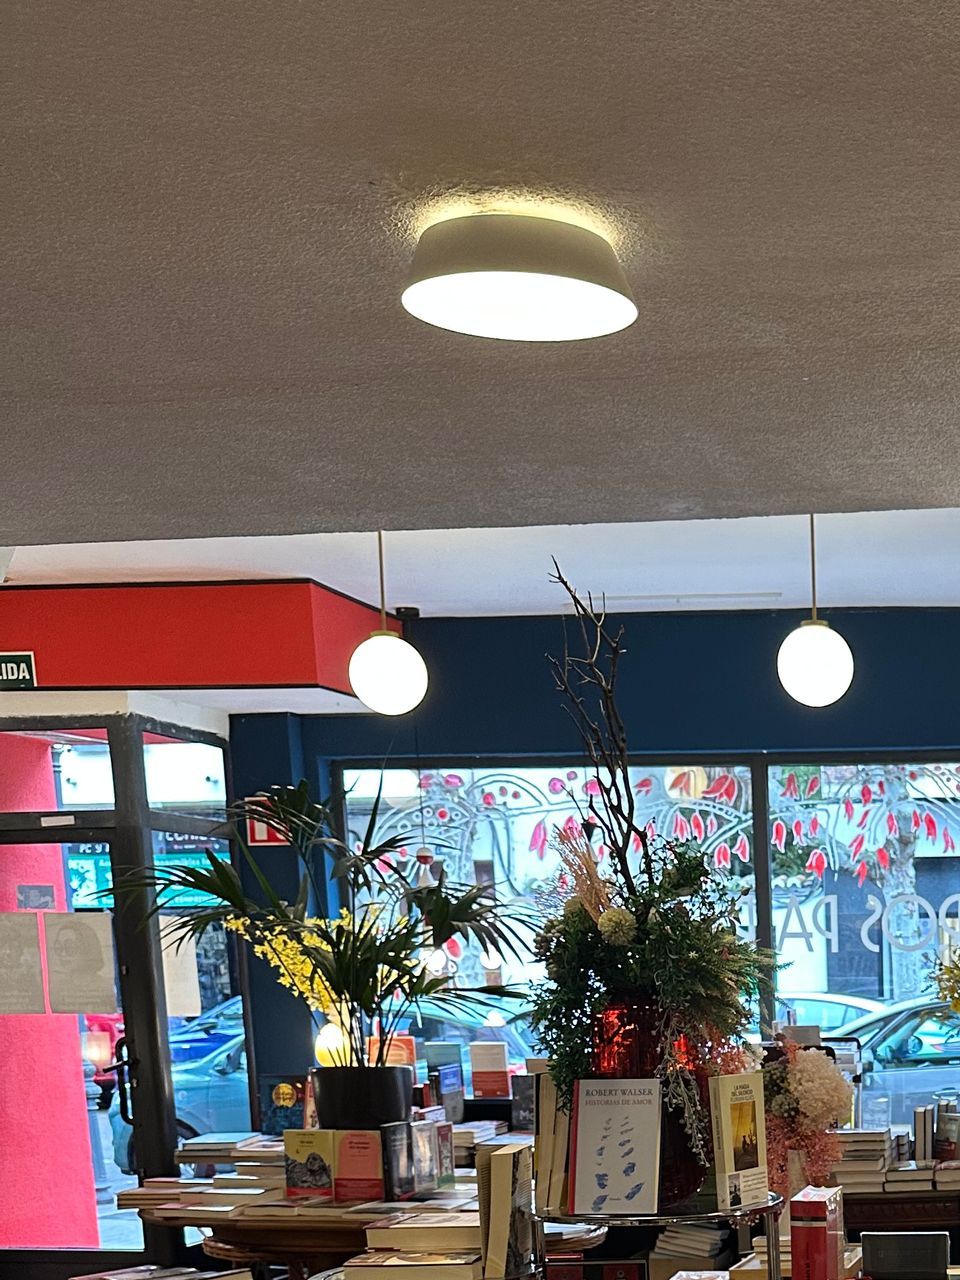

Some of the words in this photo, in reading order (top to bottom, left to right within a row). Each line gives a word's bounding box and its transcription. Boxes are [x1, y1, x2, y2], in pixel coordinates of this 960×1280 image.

[0, 662, 30, 680] IDA
[585, 1088, 619, 1096] ROBERT
[620, 1088, 654, 1096] WALSER
[629, 1098, 653, 1106] AMOR
